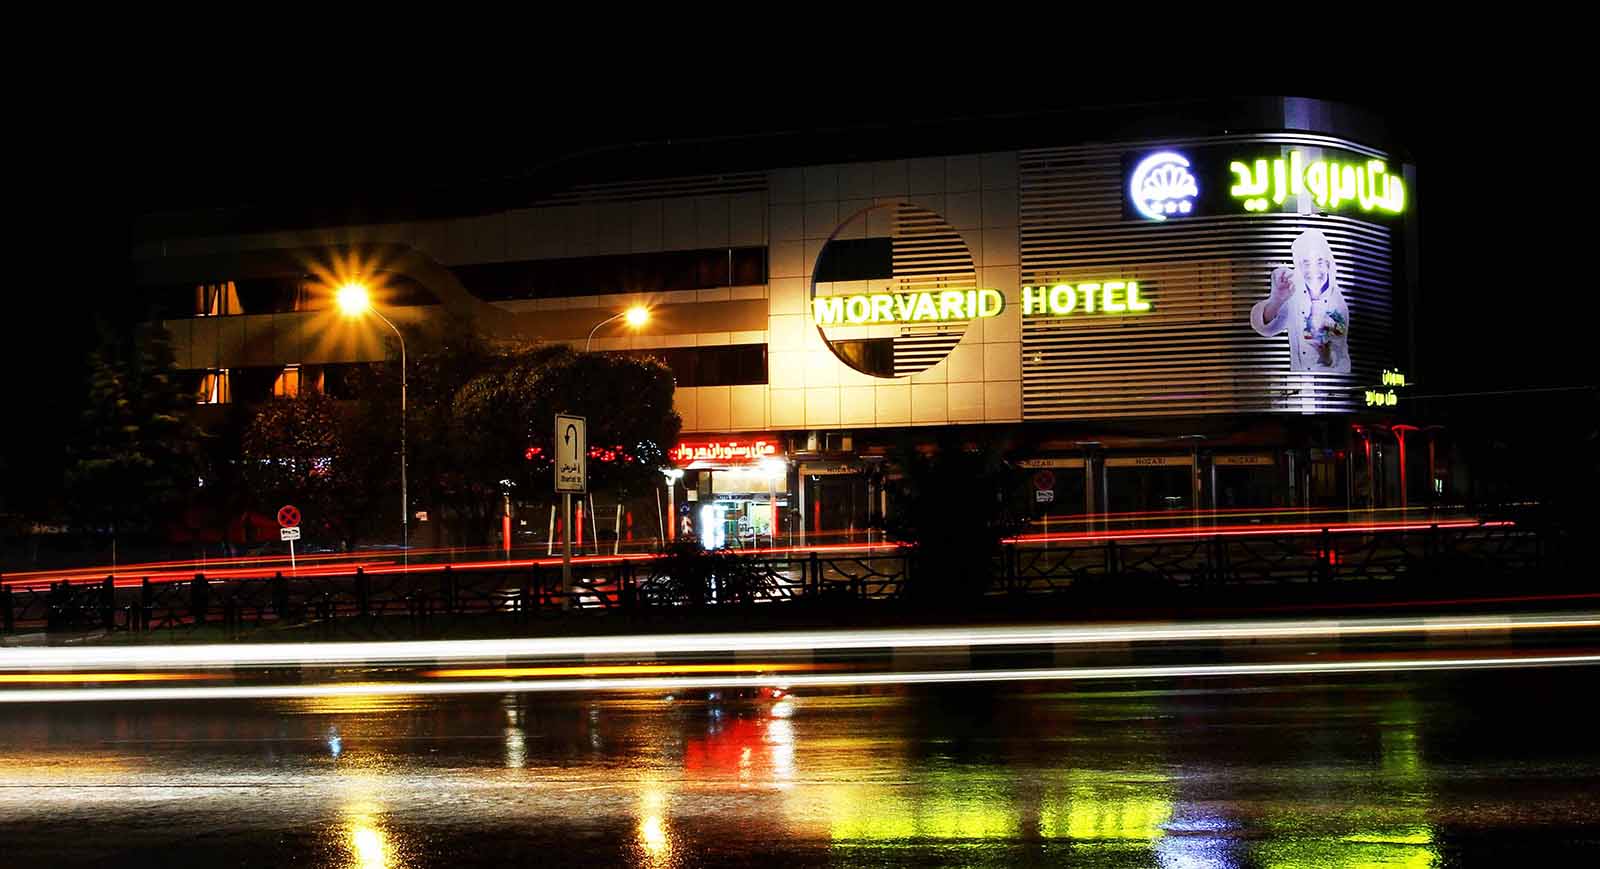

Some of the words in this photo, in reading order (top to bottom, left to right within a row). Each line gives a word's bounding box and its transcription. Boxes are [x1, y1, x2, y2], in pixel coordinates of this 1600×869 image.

[1229, 150, 1356, 212] مروارید
[1357, 159, 1404, 212] هتل
[813, 288, 1004, 325] MORVARID
[1022, 280, 1152, 315] HOTEL
[707, 442, 752, 460] رستوران
[752, 441, 775, 458] هتل
